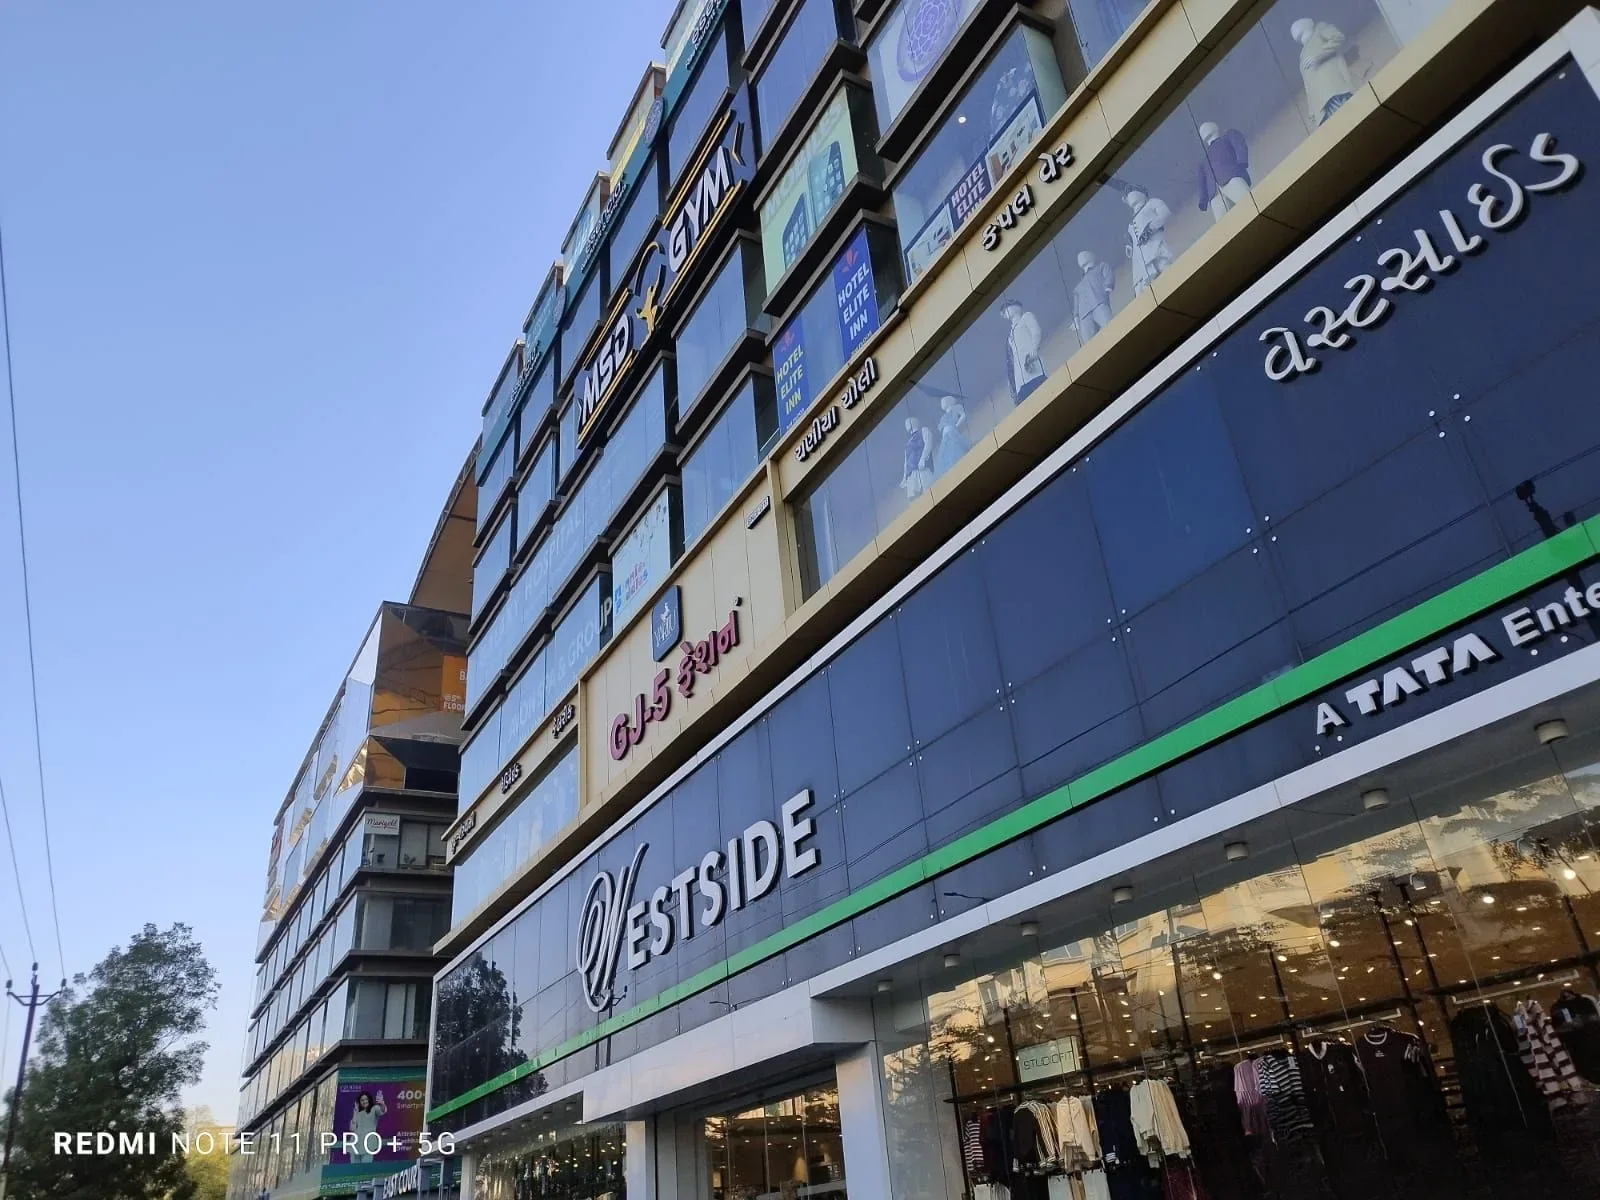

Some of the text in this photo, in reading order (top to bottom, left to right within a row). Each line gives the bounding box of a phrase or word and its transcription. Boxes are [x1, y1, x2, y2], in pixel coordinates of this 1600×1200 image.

[951, 161, 985, 208] HOTEL
[956, 178, 986, 220] ELITE
[982, 142, 1072, 251] કપલ વેર
[668, 145, 731, 273] GYM
[838, 261, 870, 307] HOTEL
[843, 283, 870, 325] ELITE
[849, 309, 868, 341] INN
[582, 313, 630, 425] MSD
[776, 344, 804, 384] HOTEL
[780, 364, 804, 400] ELITE
[841, 357, 876, 410] ચોલી
[785, 387, 801, 415] INN
[568, 597, 613, 668] GROUP
[1317, 581, 1600, 735] A TATA Ente
[610, 667, 671, 761] GJ-5
[576, 788, 818, 1013] WESTSIDE
[396, 1090, 425, 1101] 400
[398, 1164, 418, 1195] COUR
